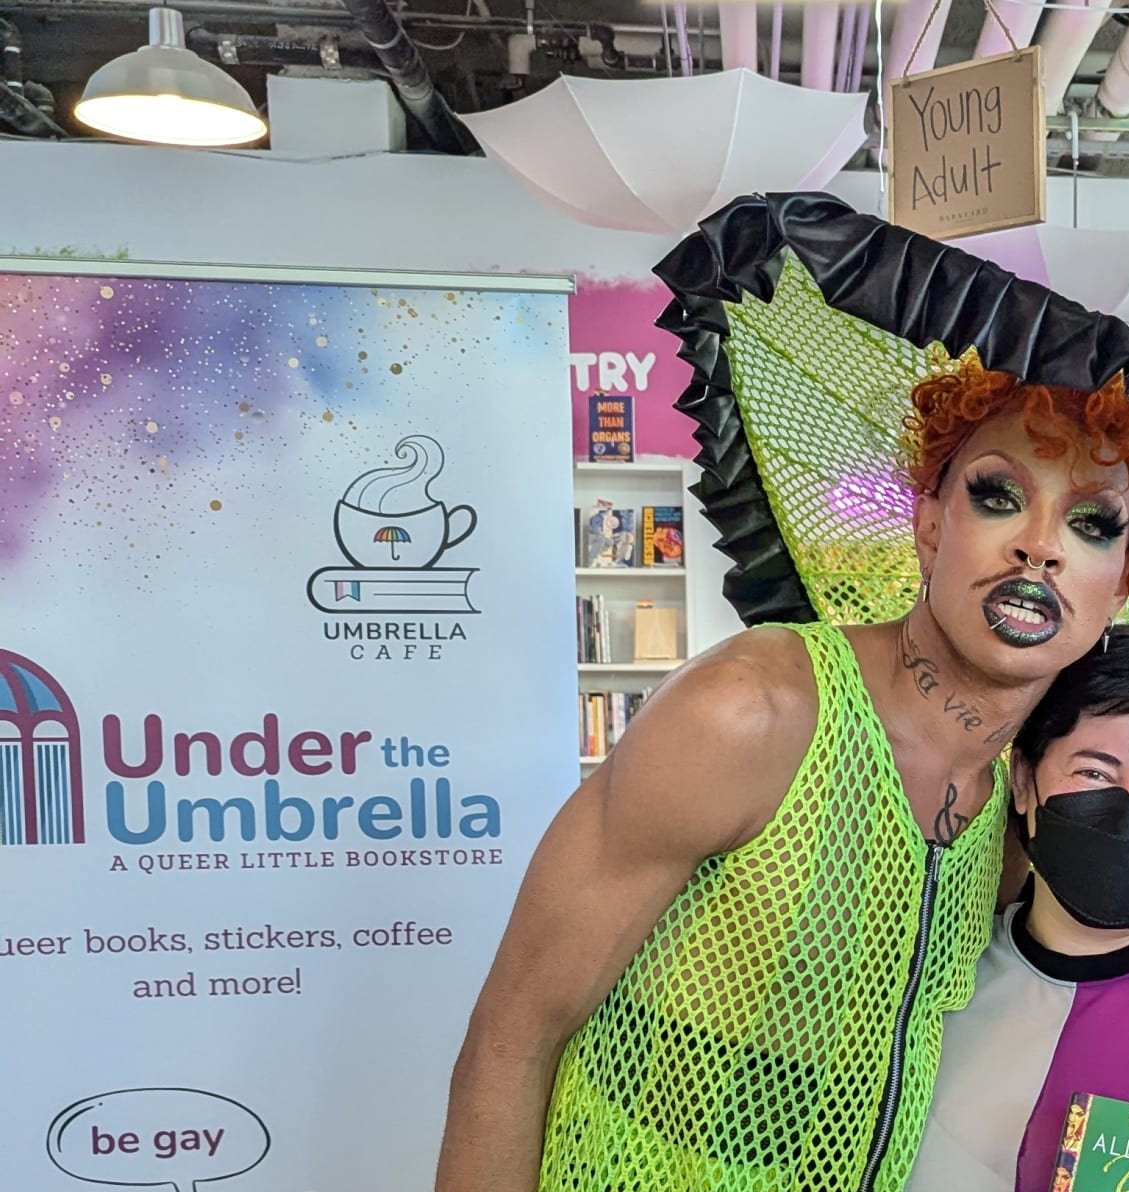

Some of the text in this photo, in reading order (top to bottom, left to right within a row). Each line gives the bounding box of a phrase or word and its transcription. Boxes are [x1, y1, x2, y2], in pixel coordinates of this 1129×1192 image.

[909, 86, 1001, 152] Young
[912, 145, 1001, 210] Adult
[597, 402, 625, 413] MORE
[599, 417, 624, 427] THAN
[592, 432, 631, 443] ORGANS
[324, 622, 467, 641] UMBRELLA
[102, 713, 450, 778] Under the
[105, 777, 501, 845] Umbrella
[110, 848, 503, 874] A QUEER LITTLE BOOKSTORE
[84, 928, 193, 954] books,
[204, 925, 342, 951] stickers,
[352, 922, 453, 946] coffee
[133, 968, 302, 998] and more!
[91, 1126, 224, 1159] be gay
